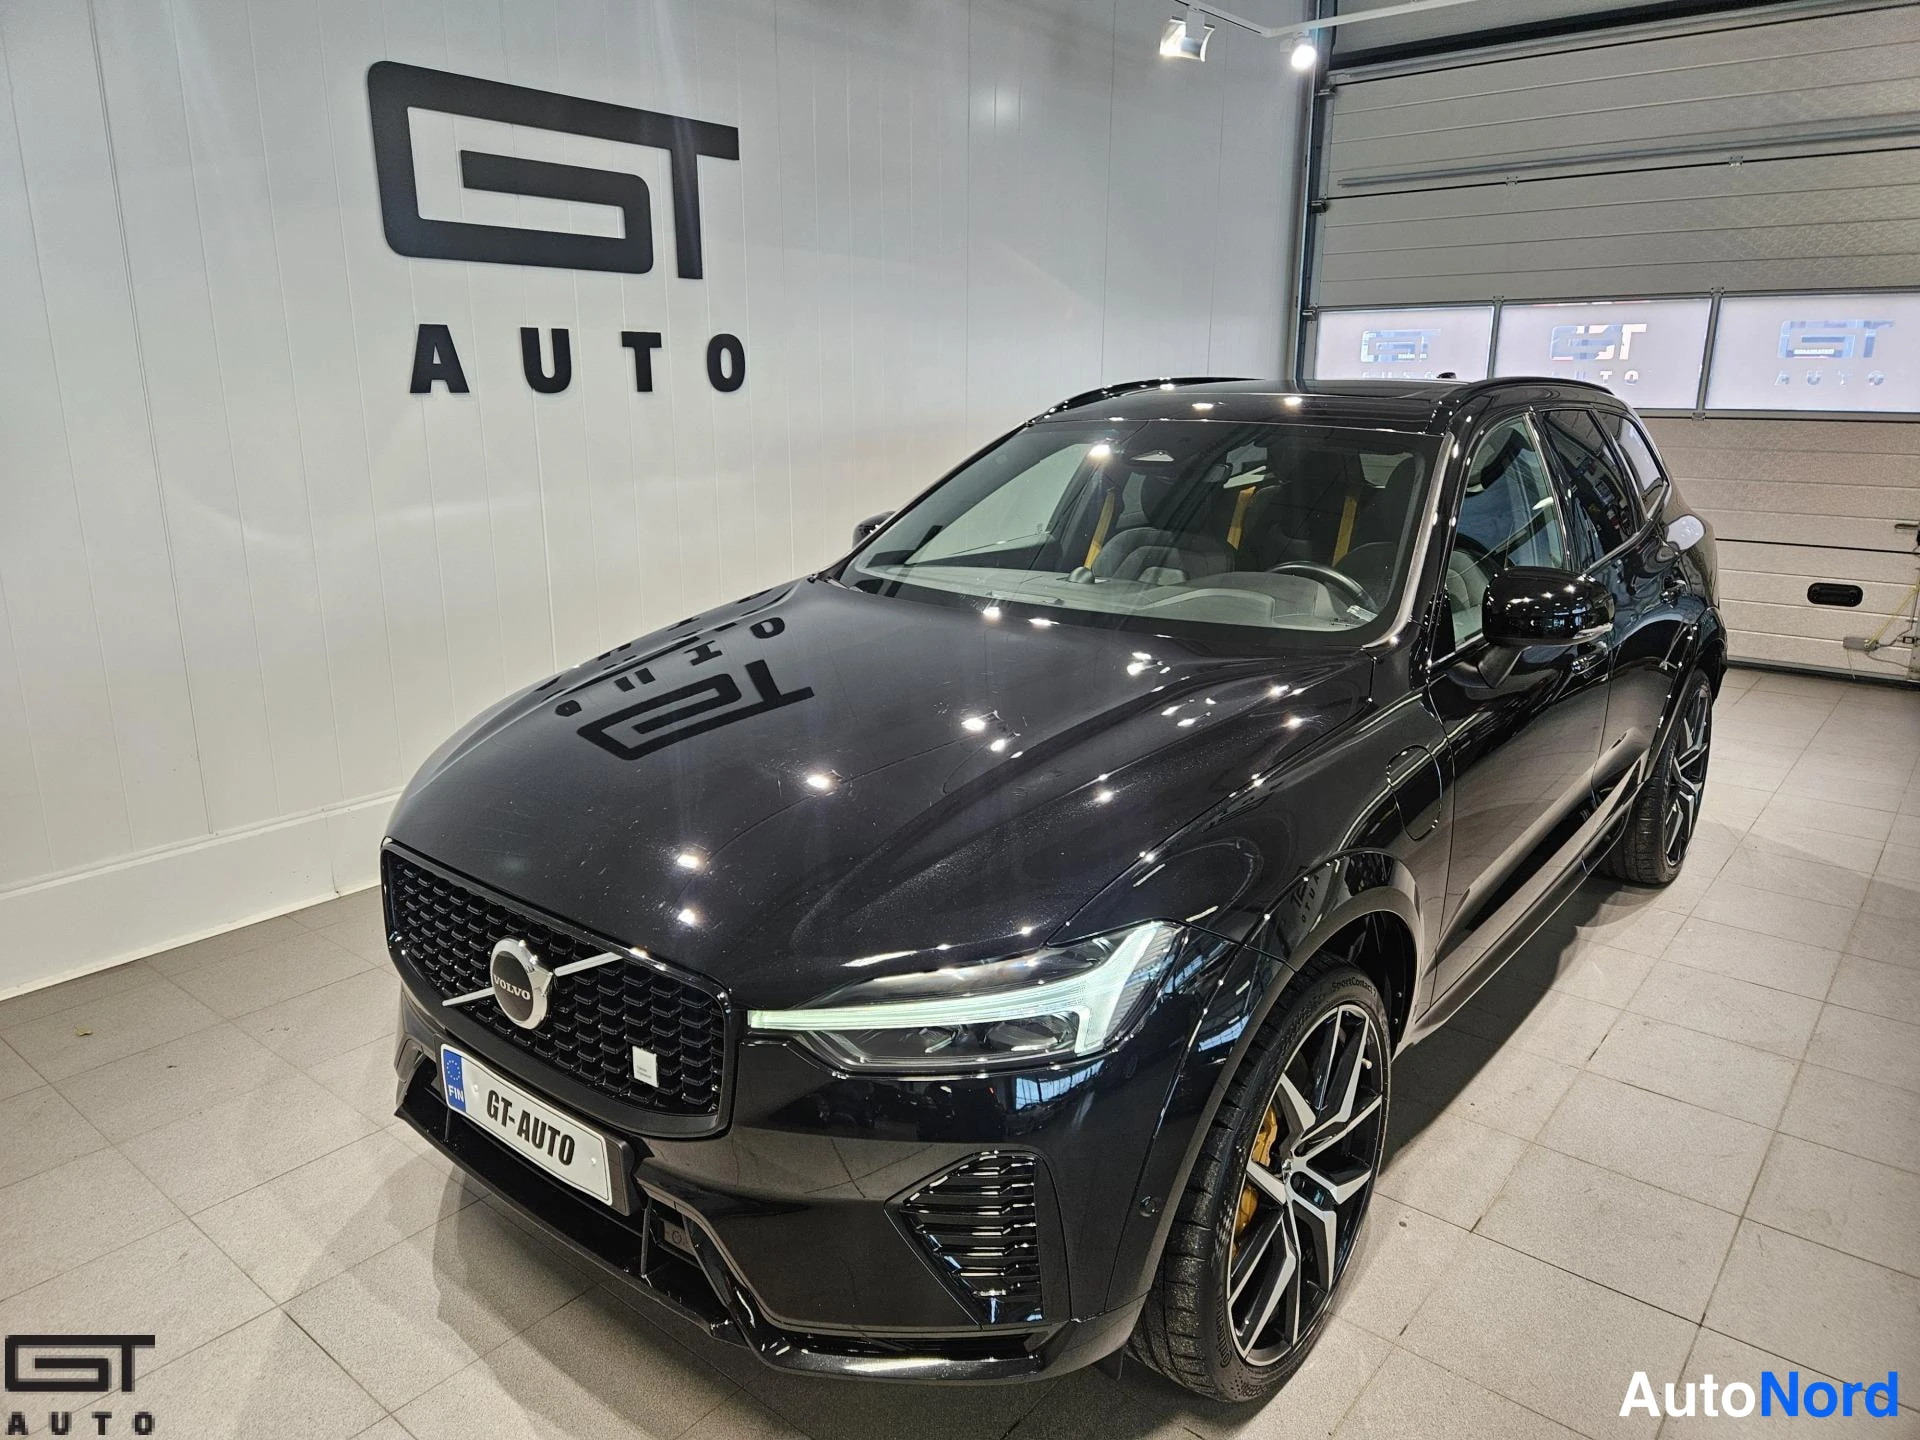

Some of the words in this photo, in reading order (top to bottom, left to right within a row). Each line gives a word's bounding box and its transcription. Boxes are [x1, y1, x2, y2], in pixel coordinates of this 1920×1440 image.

[367, 60, 740, 280] GT
[409, 323, 746, 394] AUTO
[493, 973, 531, 1001] VOLVO
[449, 1085, 465, 1103] FIN
[486, 1089, 575, 1166] GT-AUTO
